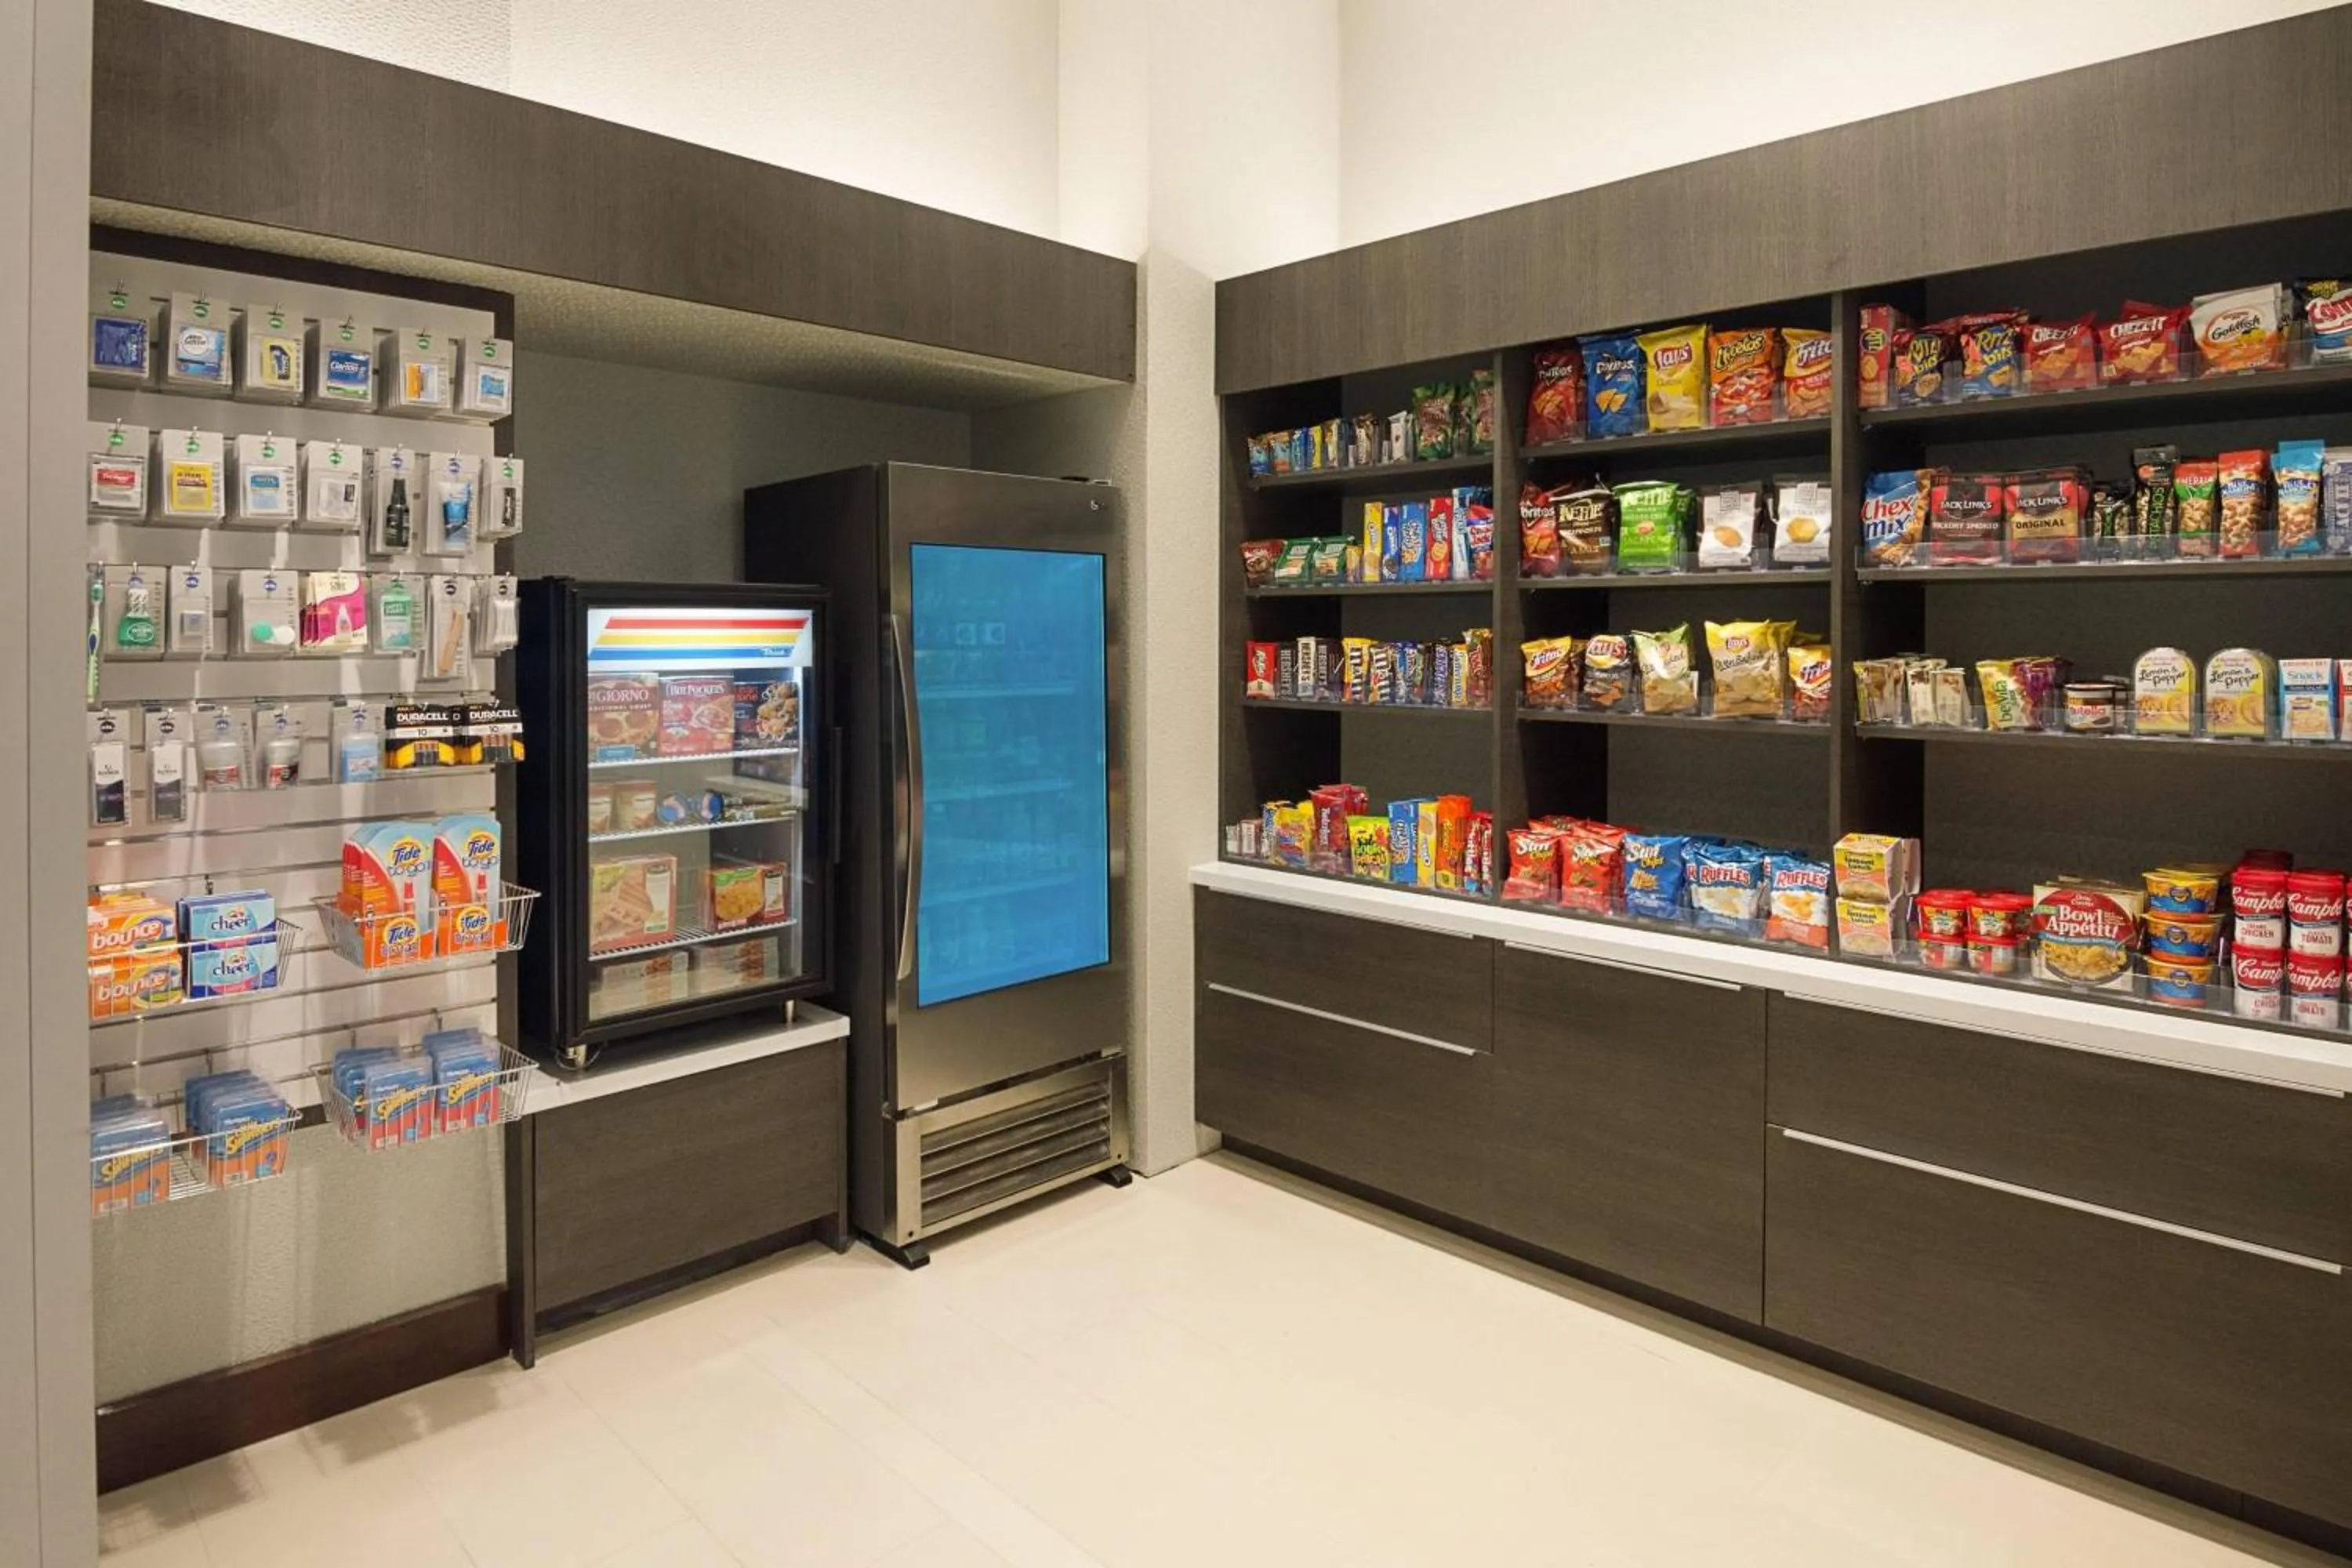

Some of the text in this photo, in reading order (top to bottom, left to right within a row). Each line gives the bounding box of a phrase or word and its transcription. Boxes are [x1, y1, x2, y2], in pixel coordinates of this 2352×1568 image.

[2212, 314, 2261, 340] Goldfish
[1795, 338, 1832, 367] Frito
[1860, 496, 1913, 521] Chex
[2015, 518, 2067, 530] ORIGINAL
[396, 712, 449, 722] DURACELL
[470, 709, 518, 719] DURACELL
[394, 846, 421, 866] Tide
[467, 839, 495, 858] Tide
[1700, 865, 1751, 884] RUFFLES
[1776, 869, 1828, 889] RUFFLES
[210, 913, 252, 932] cheer
[2057, 904, 2103, 925] Bowl
[92, 920, 161, 949] bounce
[212, 959, 255, 978] cheer
[96, 971, 166, 1001] bounce
